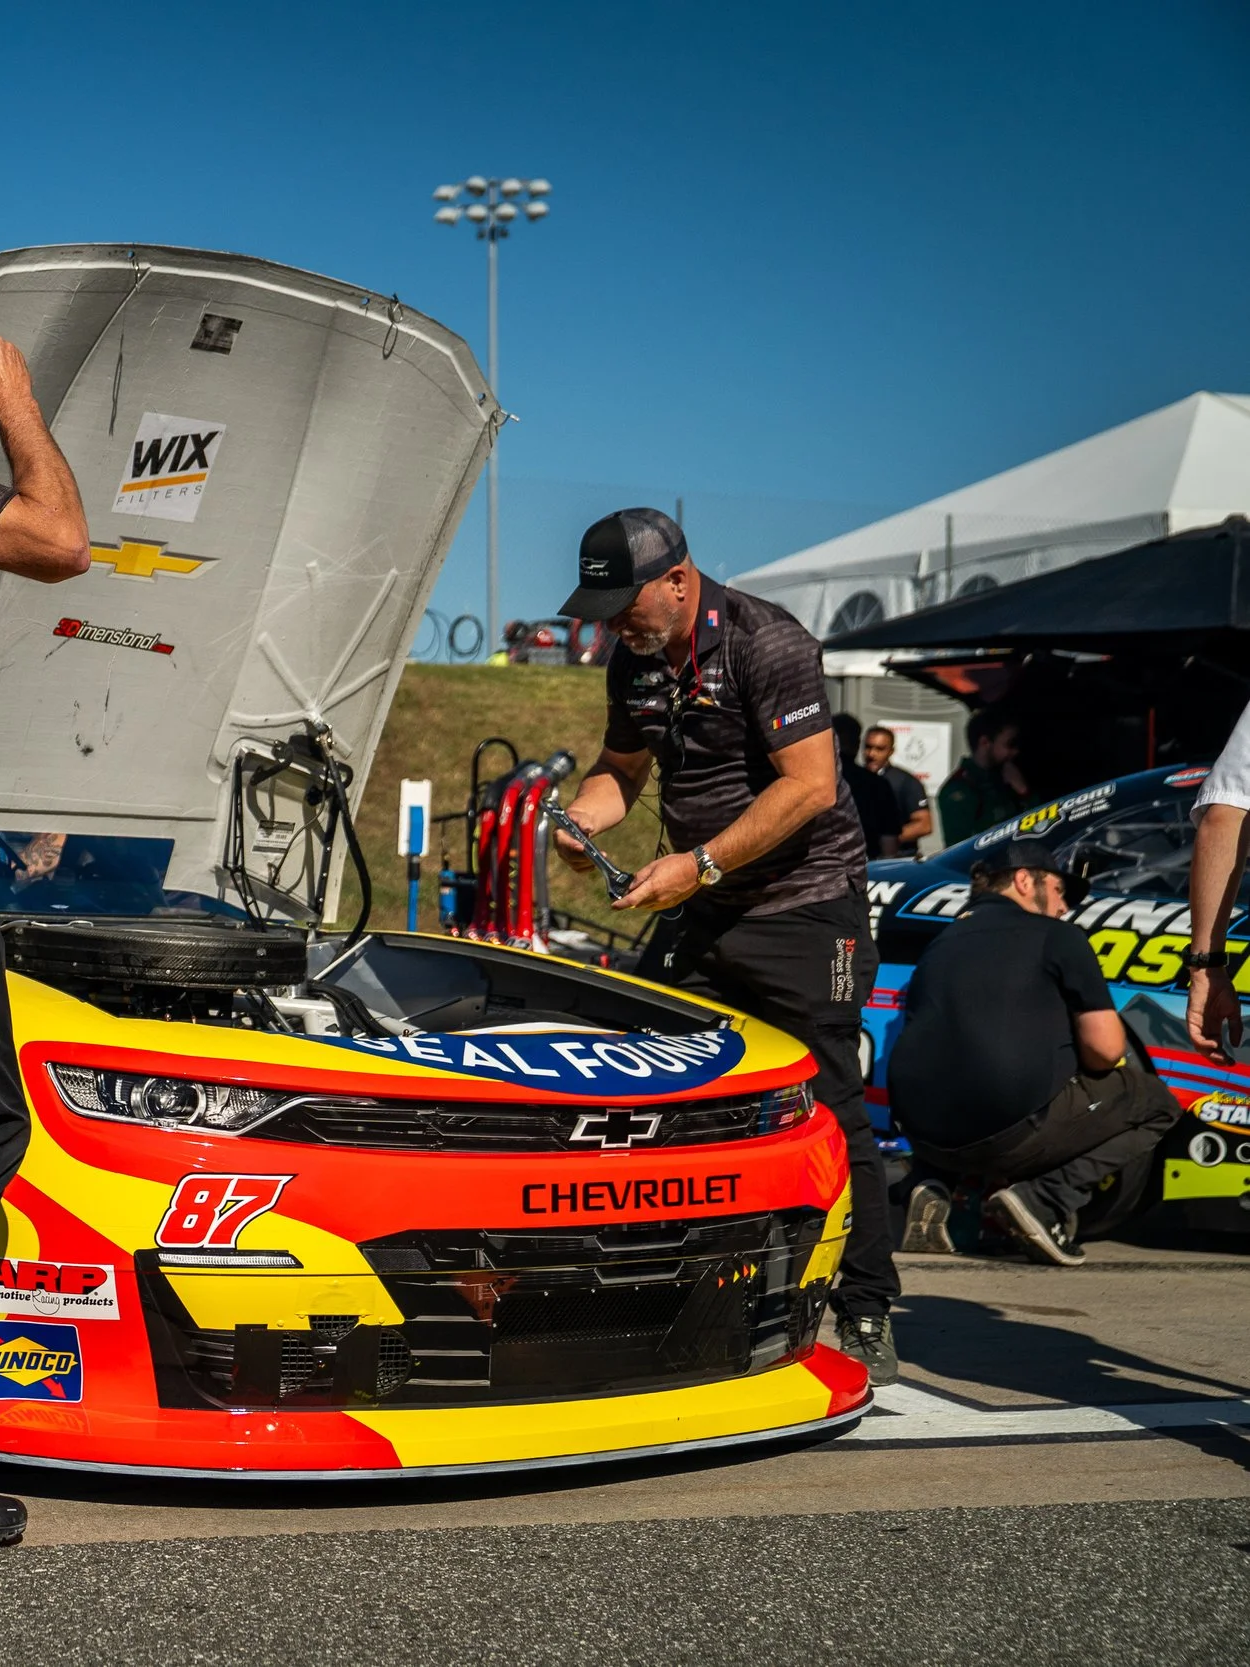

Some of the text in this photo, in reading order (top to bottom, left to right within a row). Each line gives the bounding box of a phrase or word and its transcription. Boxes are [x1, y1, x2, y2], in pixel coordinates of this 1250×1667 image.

[131, 430, 219, 479] WIX
[115, 485, 203, 506] FILTERS
[54, 618, 161, 651] 3Dimensional
[785, 702, 820, 724] NASCAR
[1198, 1100, 1250, 1126] STA
[521, 1173, 742, 1215] CHEVROLET
[156, 1173, 296, 1250] 87
[63, 1295, 114, 1307] products
